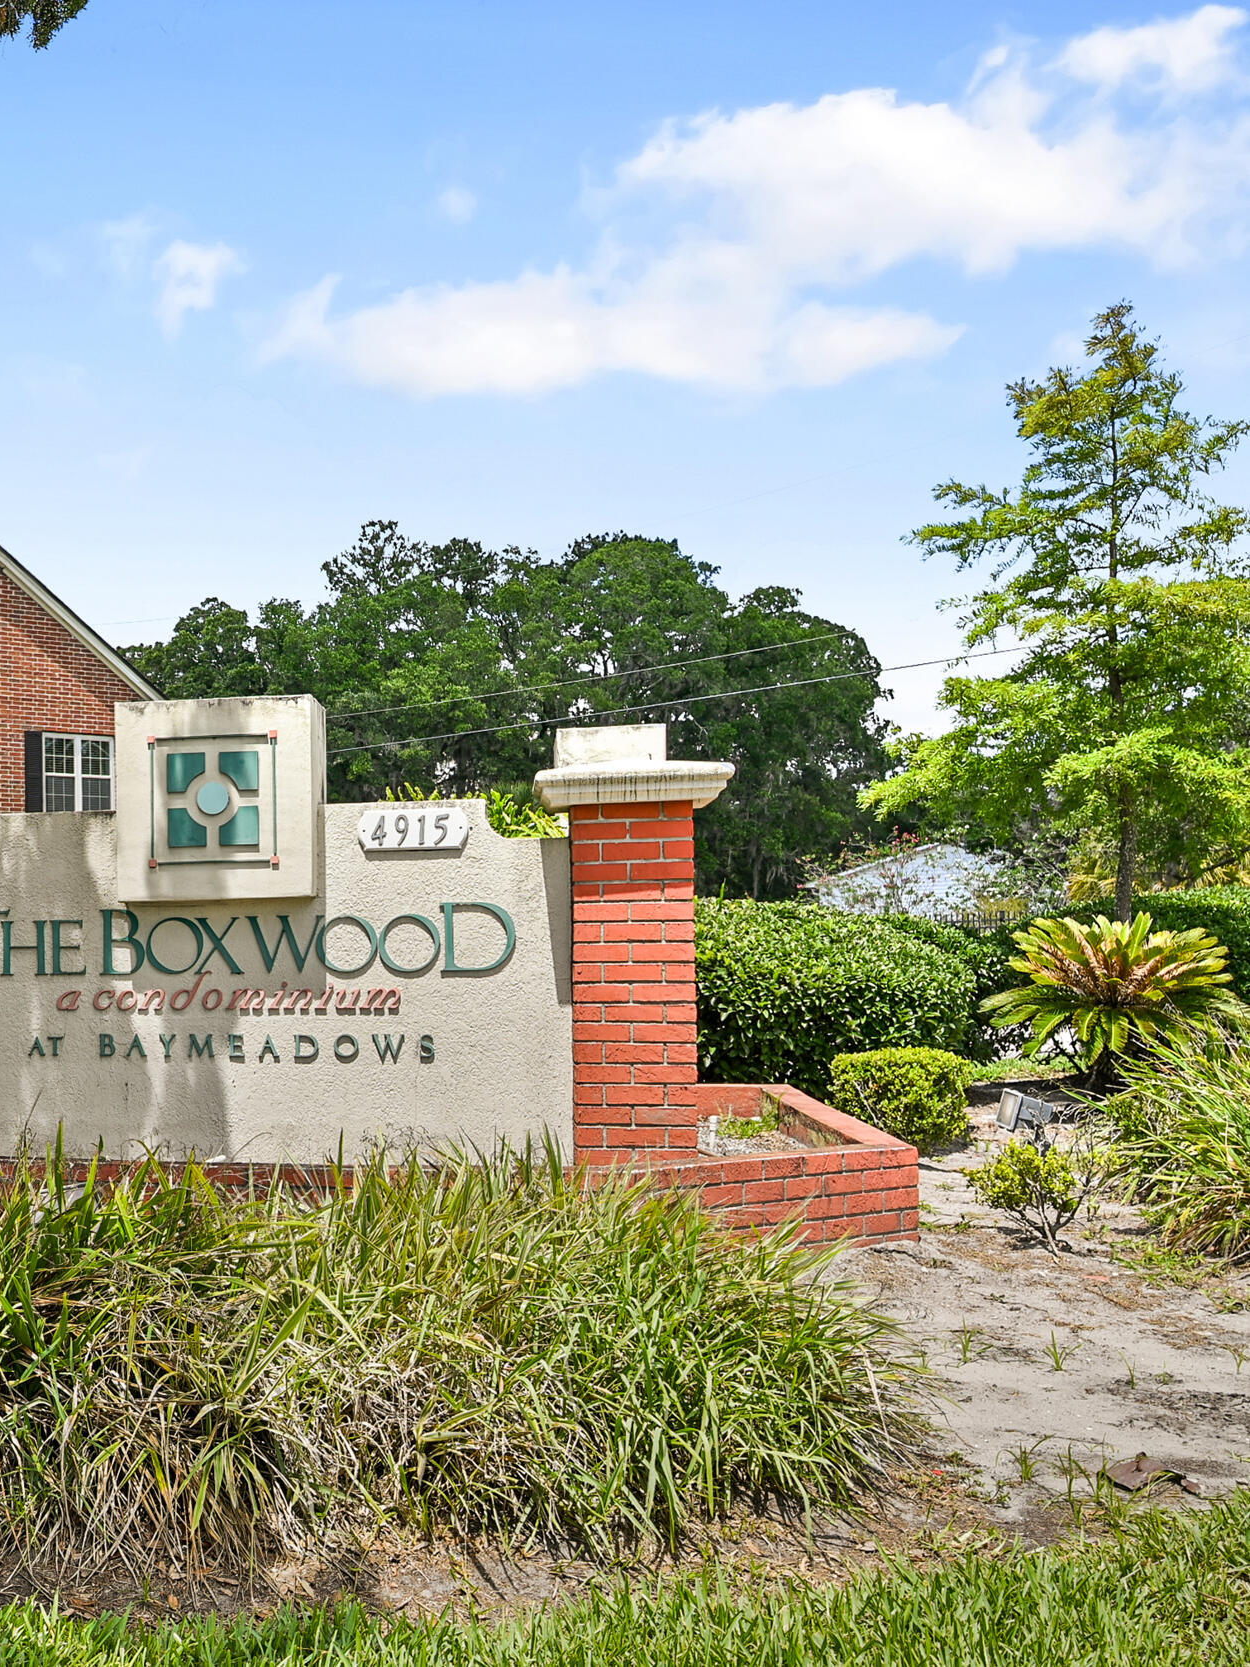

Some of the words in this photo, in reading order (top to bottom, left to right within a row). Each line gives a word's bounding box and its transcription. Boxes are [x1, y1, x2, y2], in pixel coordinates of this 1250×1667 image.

[370, 813, 450, 848] 4915
[100, 902, 517, 978] BOXWOOD
[56, 985, 81, 1012] a
[92, 971, 402, 1014] condominium
[28, 1035, 64, 1058] AT
[98, 1032, 436, 1063] BAYMEADOWS
